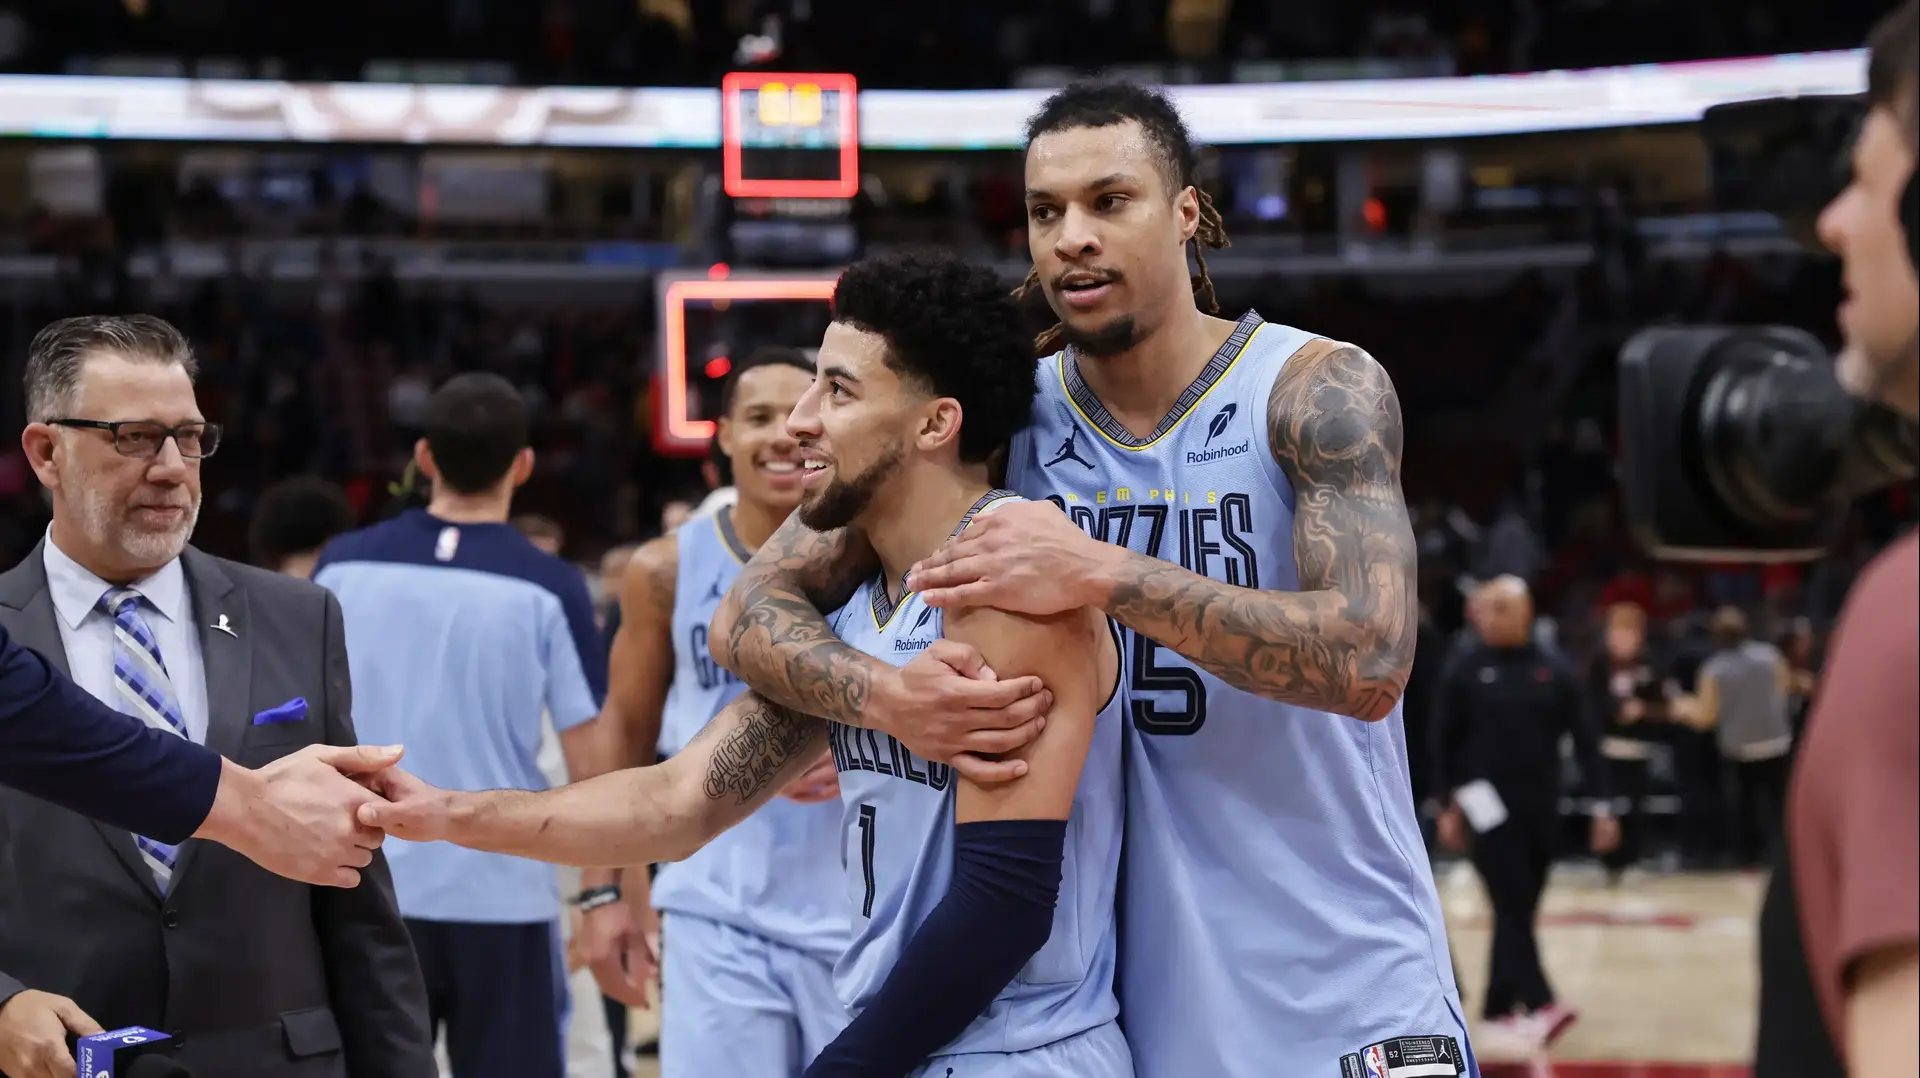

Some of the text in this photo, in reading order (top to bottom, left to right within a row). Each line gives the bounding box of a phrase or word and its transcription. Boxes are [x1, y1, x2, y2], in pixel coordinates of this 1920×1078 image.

[1187, 441, 1249, 464] Robinhood
[858, 803, 877, 919] 1
[1388, 1050, 1399, 1059] 52
